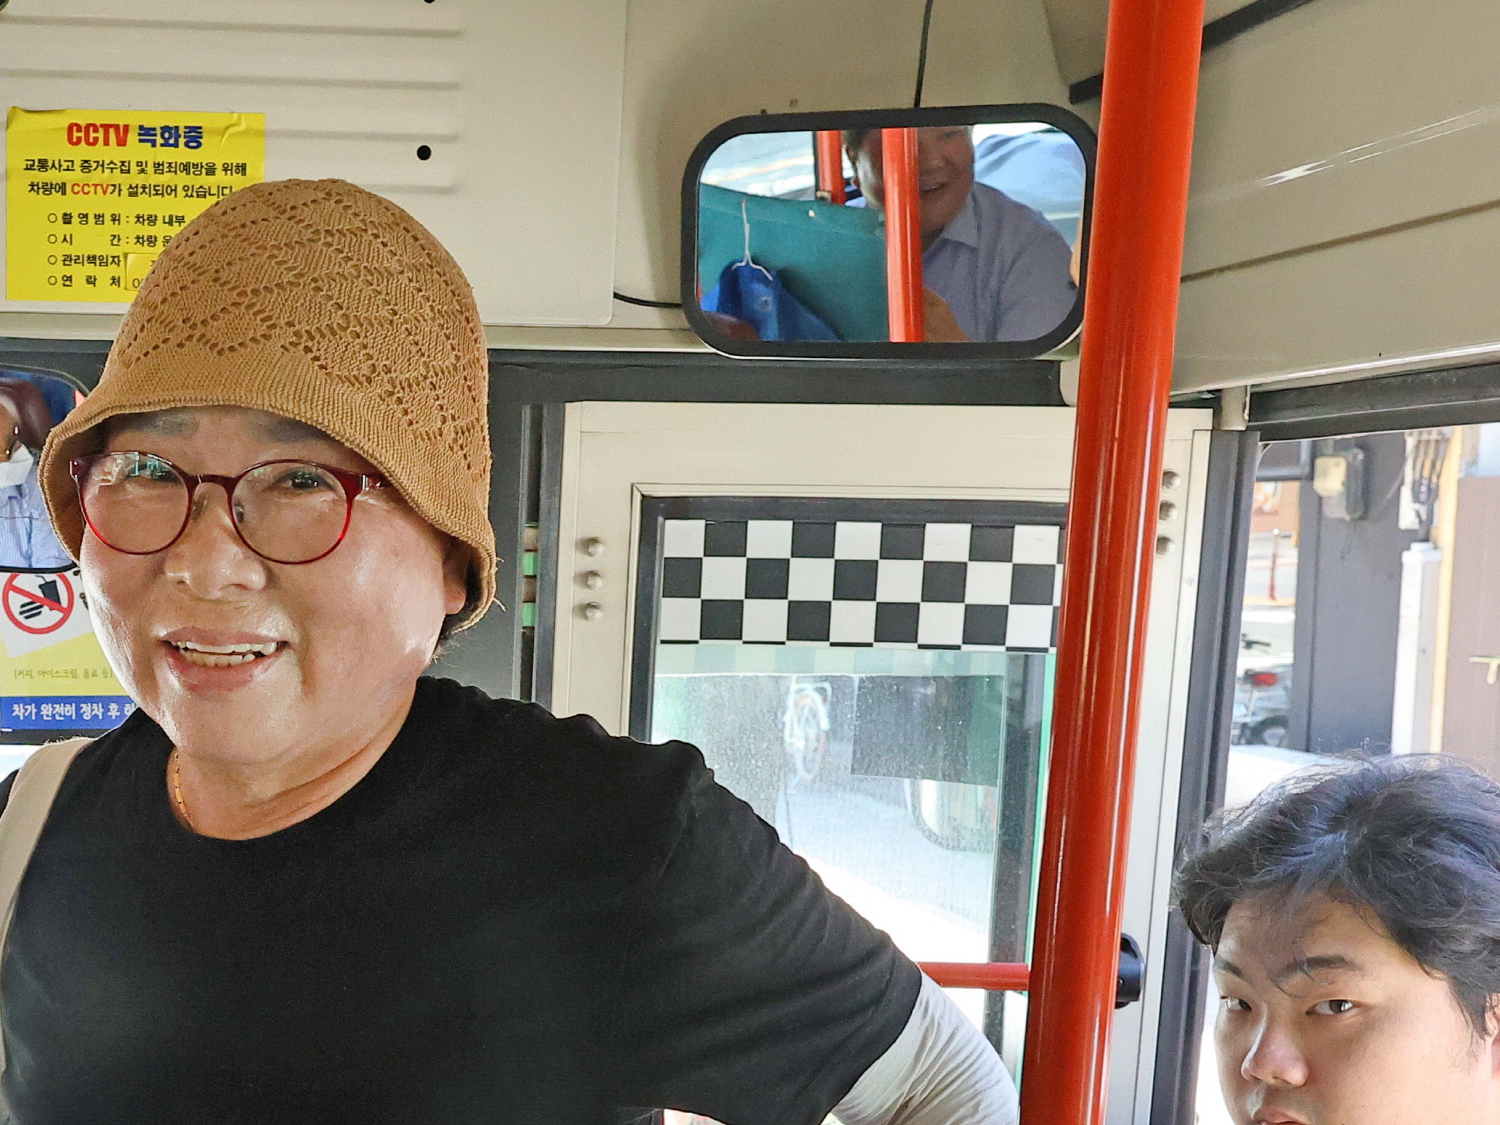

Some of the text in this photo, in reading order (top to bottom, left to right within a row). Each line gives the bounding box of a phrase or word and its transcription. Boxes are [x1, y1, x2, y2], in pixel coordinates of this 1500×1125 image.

[67, 122, 203, 149] CCTV 녹화중
[23, 159, 247, 176] 교통사고 증거수집 및 범죄예방을 위해
[28, 182, 67, 196] 차량에
[71, 183, 122, 197] CCTV가
[127, 184, 177, 198] 설치되어
[134, 213, 158, 227] 차량
[162, 214, 186, 227] 내부
[134, 235, 158, 247] 차량
[62, 255, 121, 267] 관리책임자
[12, 703, 37, 720] 차가
[40, 703, 76, 720] 완전히
[80, 703, 104, 720] 정차
[107, 702, 121, 720] 후
